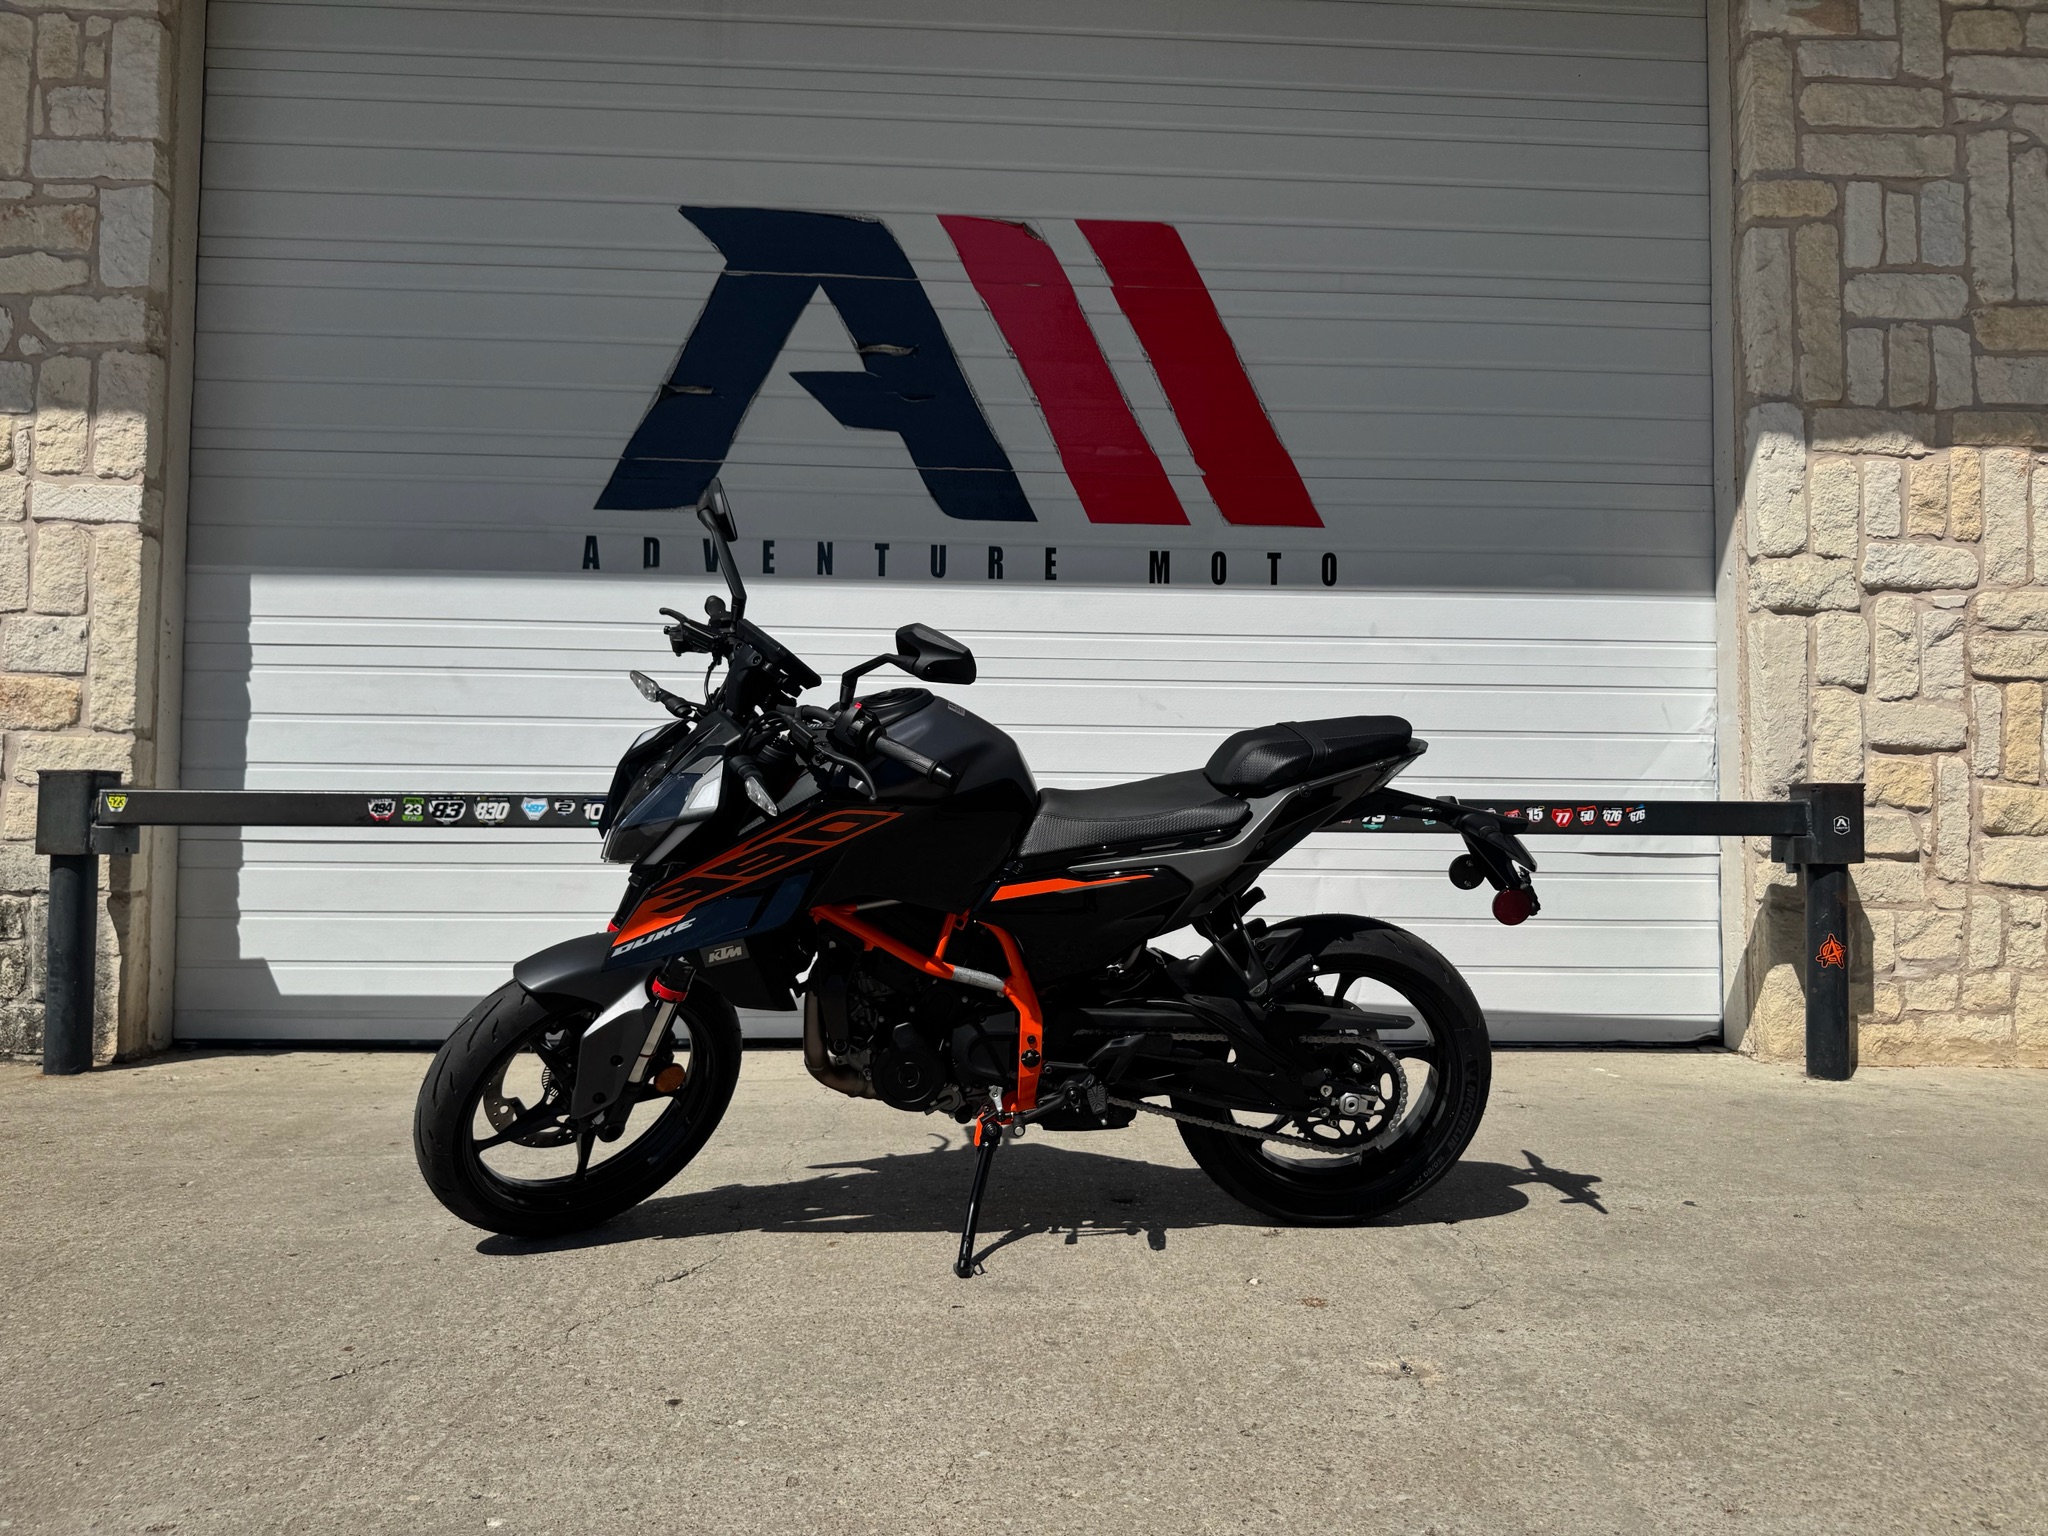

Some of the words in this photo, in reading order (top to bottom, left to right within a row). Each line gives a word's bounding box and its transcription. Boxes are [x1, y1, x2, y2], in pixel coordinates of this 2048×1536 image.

[582, 535, 1058, 581] ADVENTURE
[1149, 550, 1338, 587] MOTO
[108, 796, 126, 807] 523
[371, 802, 393, 814] 494
[404, 803, 423, 816] 23
[432, 802, 465, 818] 83
[476, 802, 511, 820] 830
[583, 803, 605, 820] 10
[1526, 808, 1543, 821] 15
[1555, 812, 1571, 824] 77
[1580, 810, 1595, 822] 50
[610, 917, 697, 958] DUKE
[708, 946, 743, 963] KTM
[1446, 1083, 1476, 1151] MICHELIN
